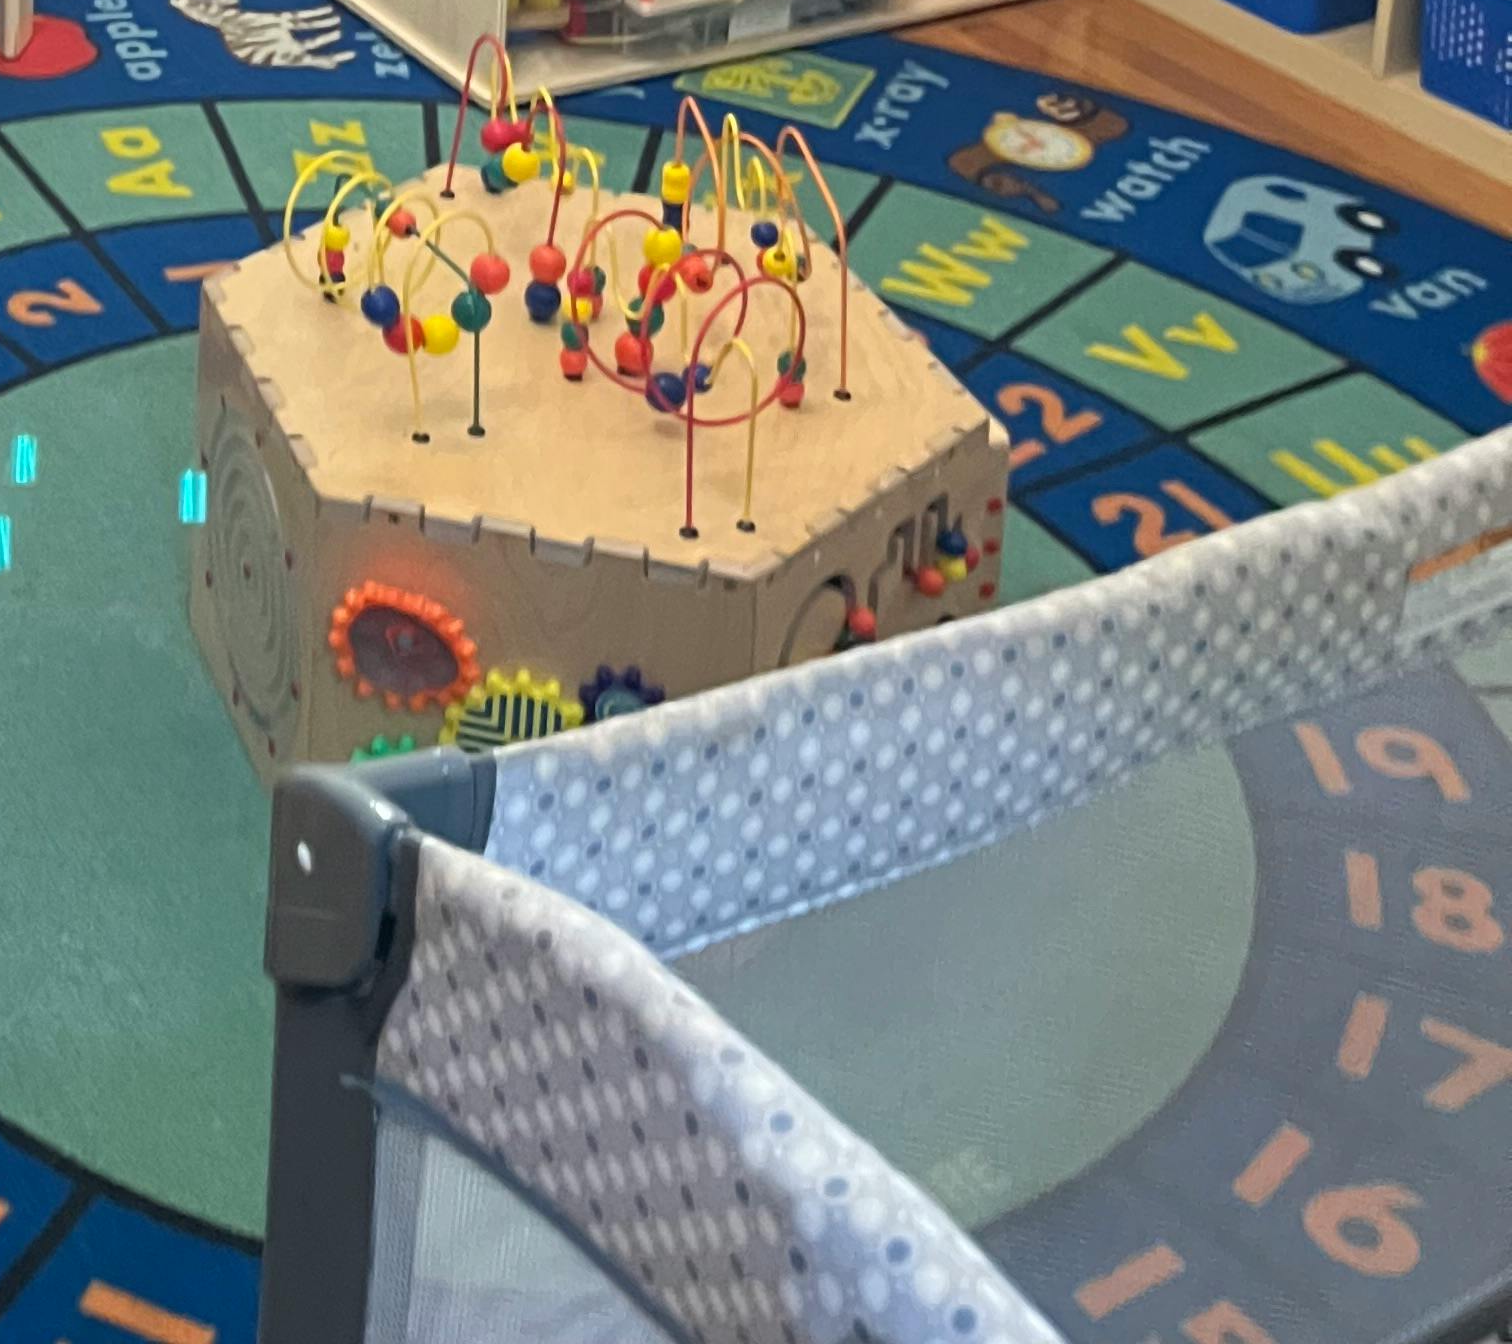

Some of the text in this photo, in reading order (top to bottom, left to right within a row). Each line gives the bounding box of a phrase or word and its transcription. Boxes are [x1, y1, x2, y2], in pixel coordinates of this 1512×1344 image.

[102, 125, 193, 198] Aa
[1080, 132, 1211, 225] watch
[5, 278, 105, 326] 2
[881, 214, 1030, 307] Ww
[1369, 265, 1490, 321] van
[1084, 312, 1241, 383] Vv
[1294, 721, 1474, 803] 19
[1344, 850, 1505, 954] 18
[1336, 992, 1512, 1112] 17
[1232, 1122, 1426, 1278] 16
